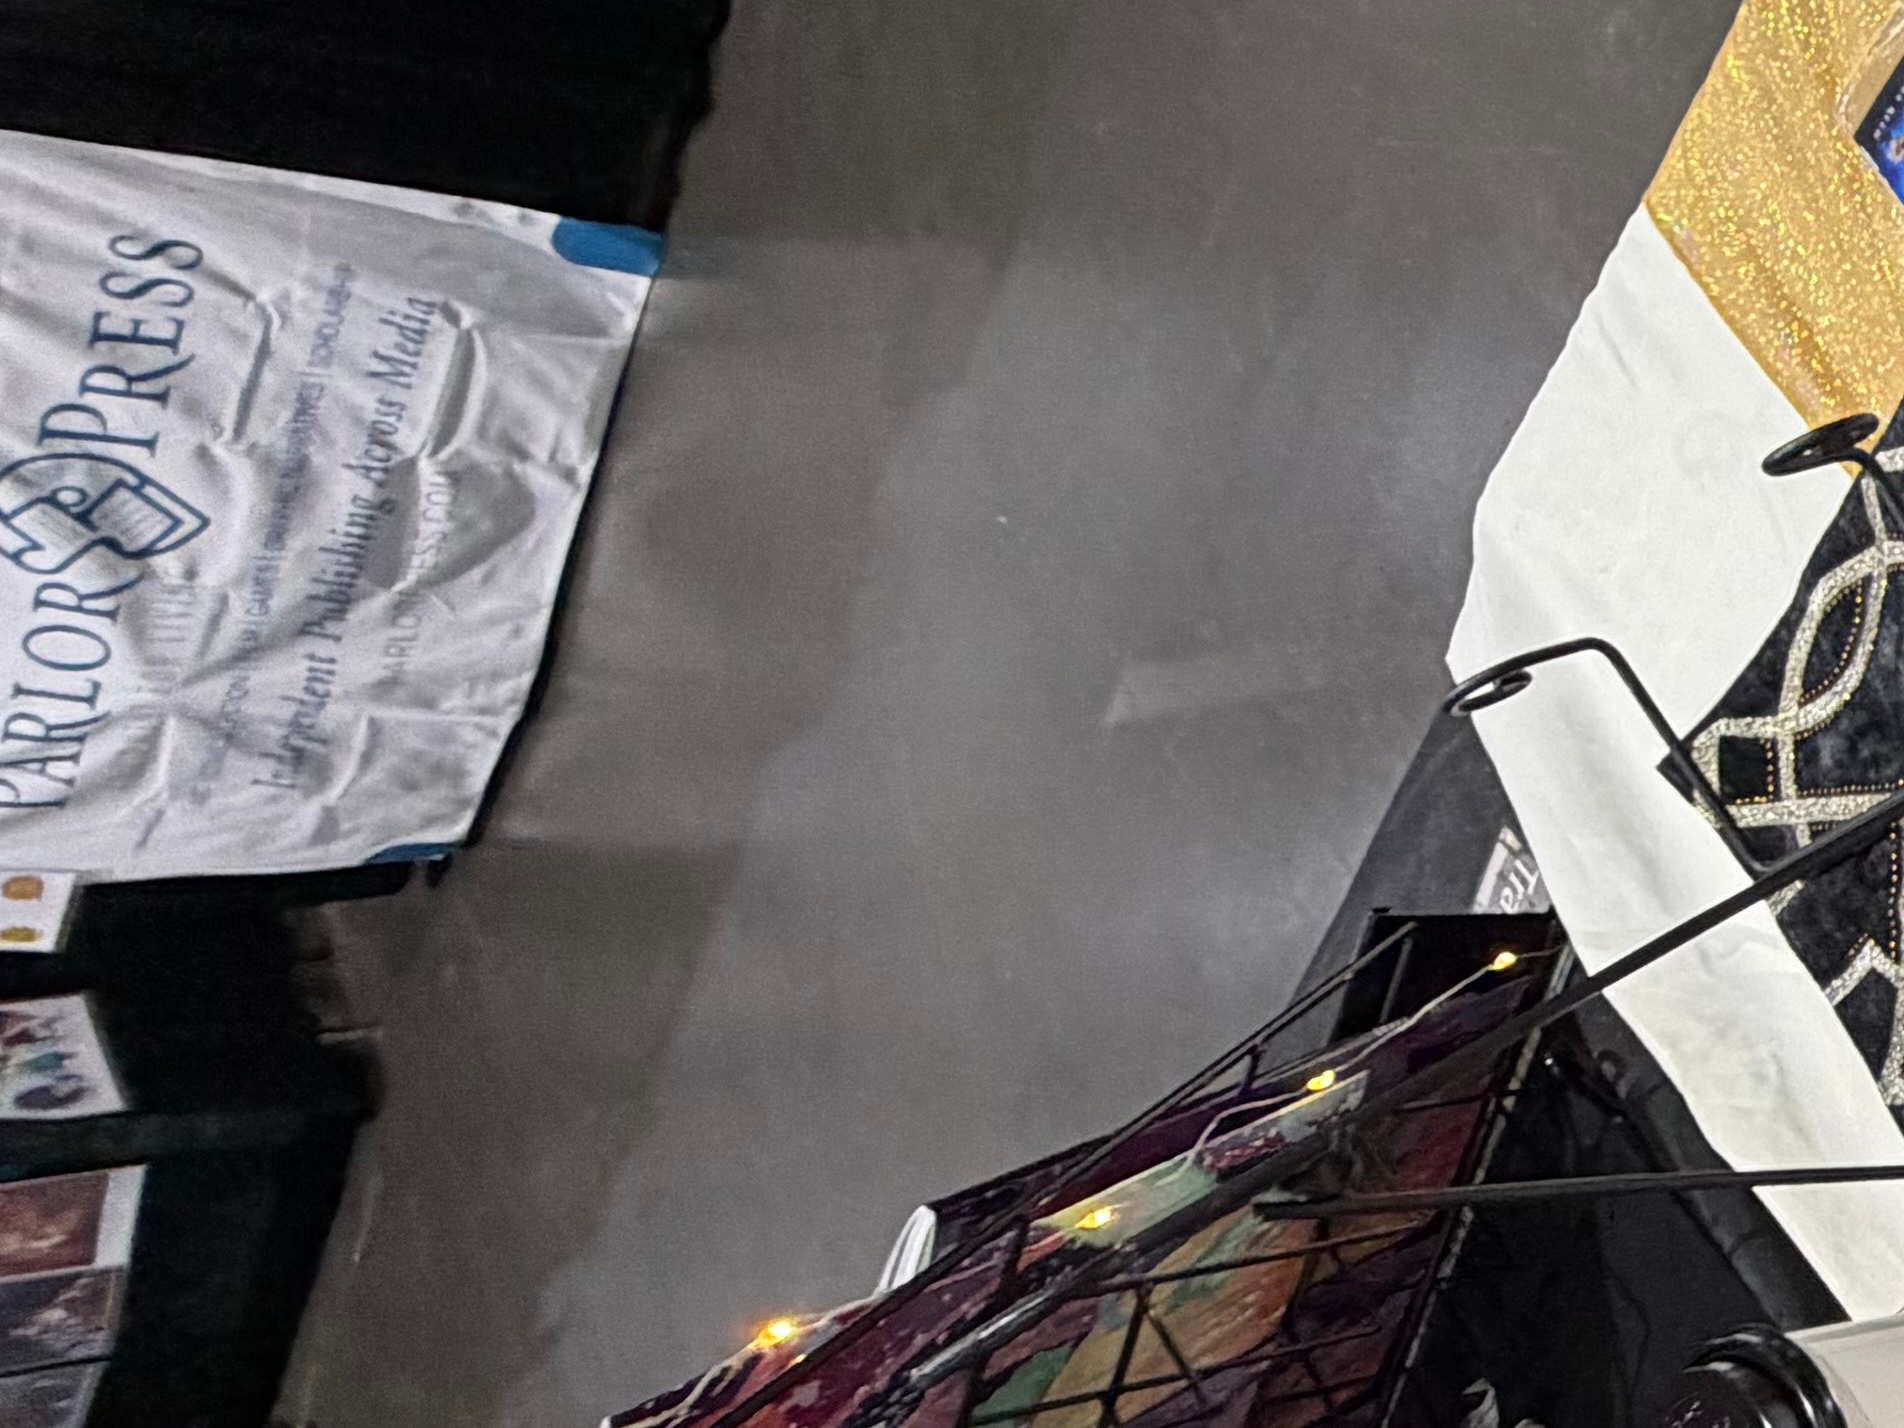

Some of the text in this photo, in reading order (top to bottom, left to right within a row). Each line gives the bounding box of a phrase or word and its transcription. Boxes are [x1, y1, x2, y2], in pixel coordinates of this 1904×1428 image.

[36, 230, 204, 457] PRESS
[366, 295, 438, 390] Media
[341, 397, 408, 483] Across
[298, 493, 394, 642] Publishing
[0, 579, 132, 810] PARLOR
